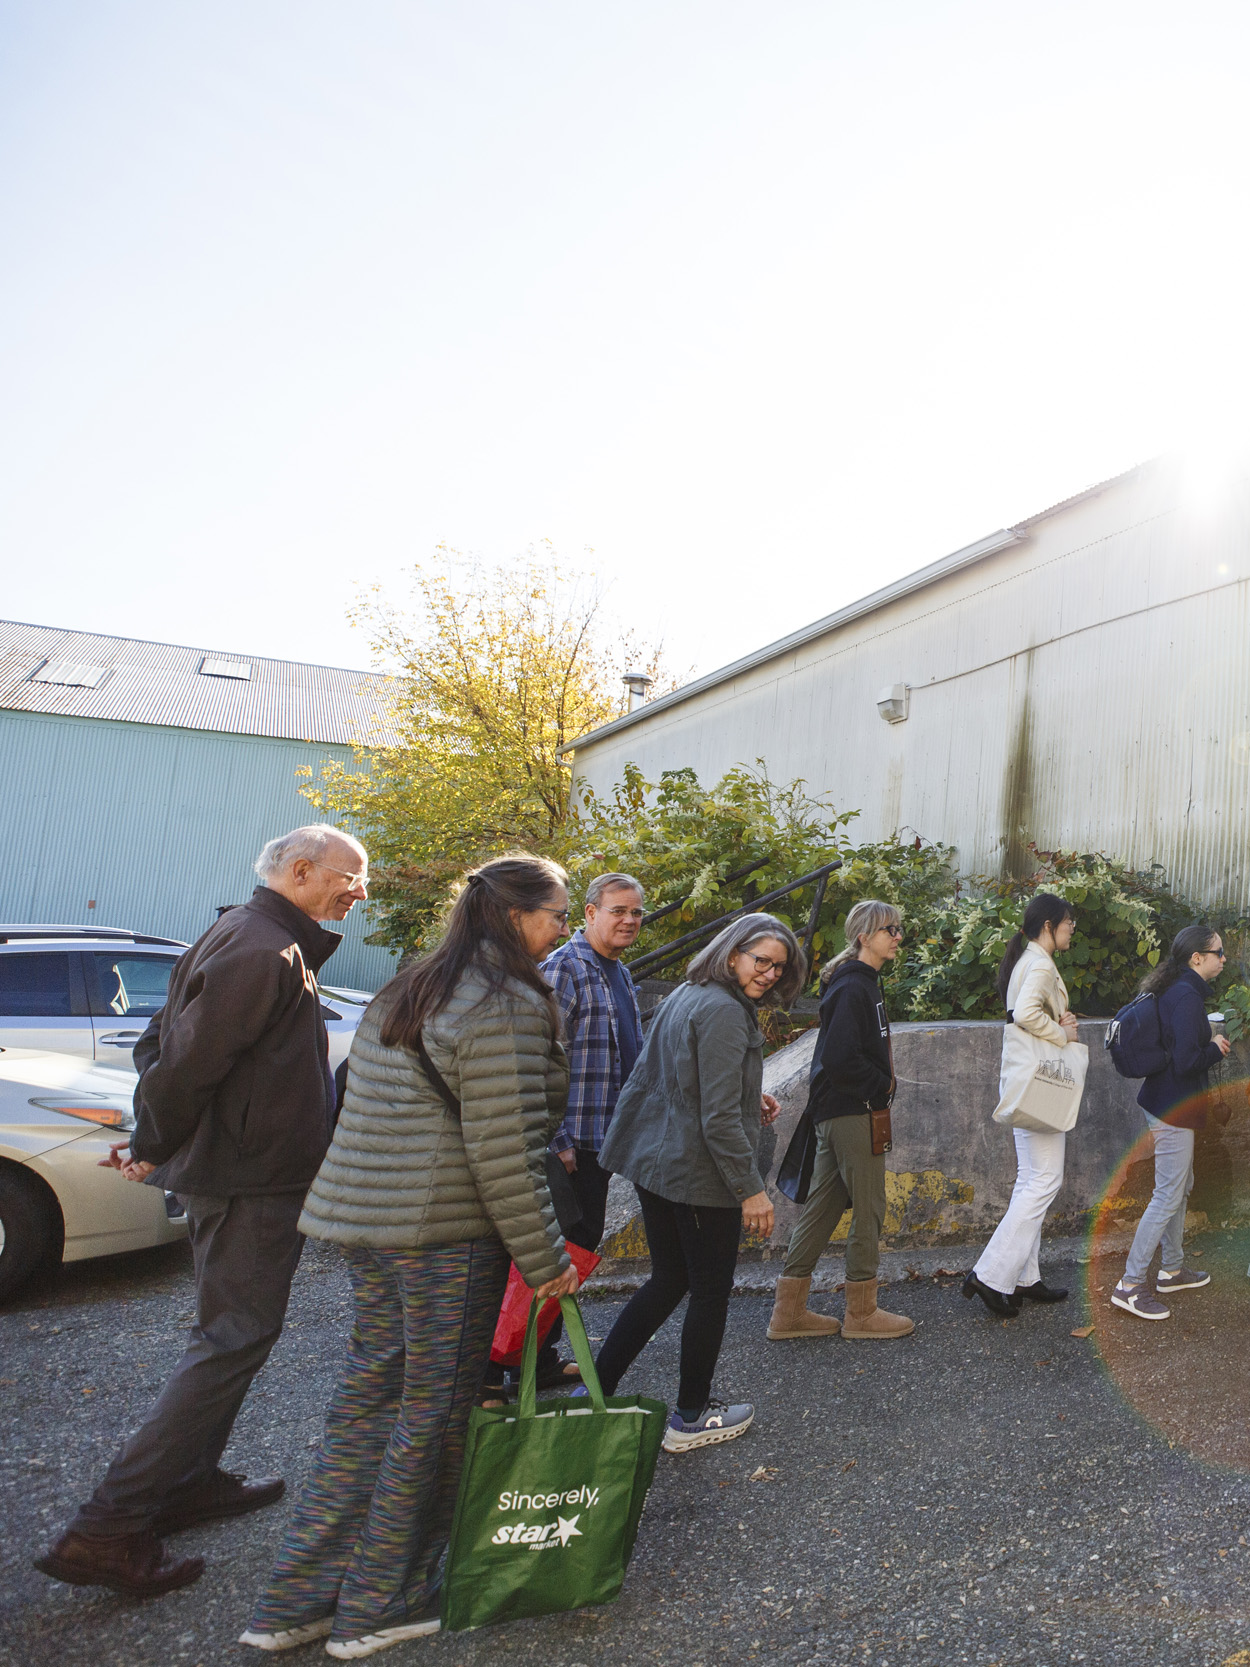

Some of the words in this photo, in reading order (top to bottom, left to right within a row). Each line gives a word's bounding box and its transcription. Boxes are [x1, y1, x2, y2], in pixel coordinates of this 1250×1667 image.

[497, 1484, 600, 1511] Sincerely,
[491, 1522, 558, 1545] star
[528, 1537, 560, 1551] market
